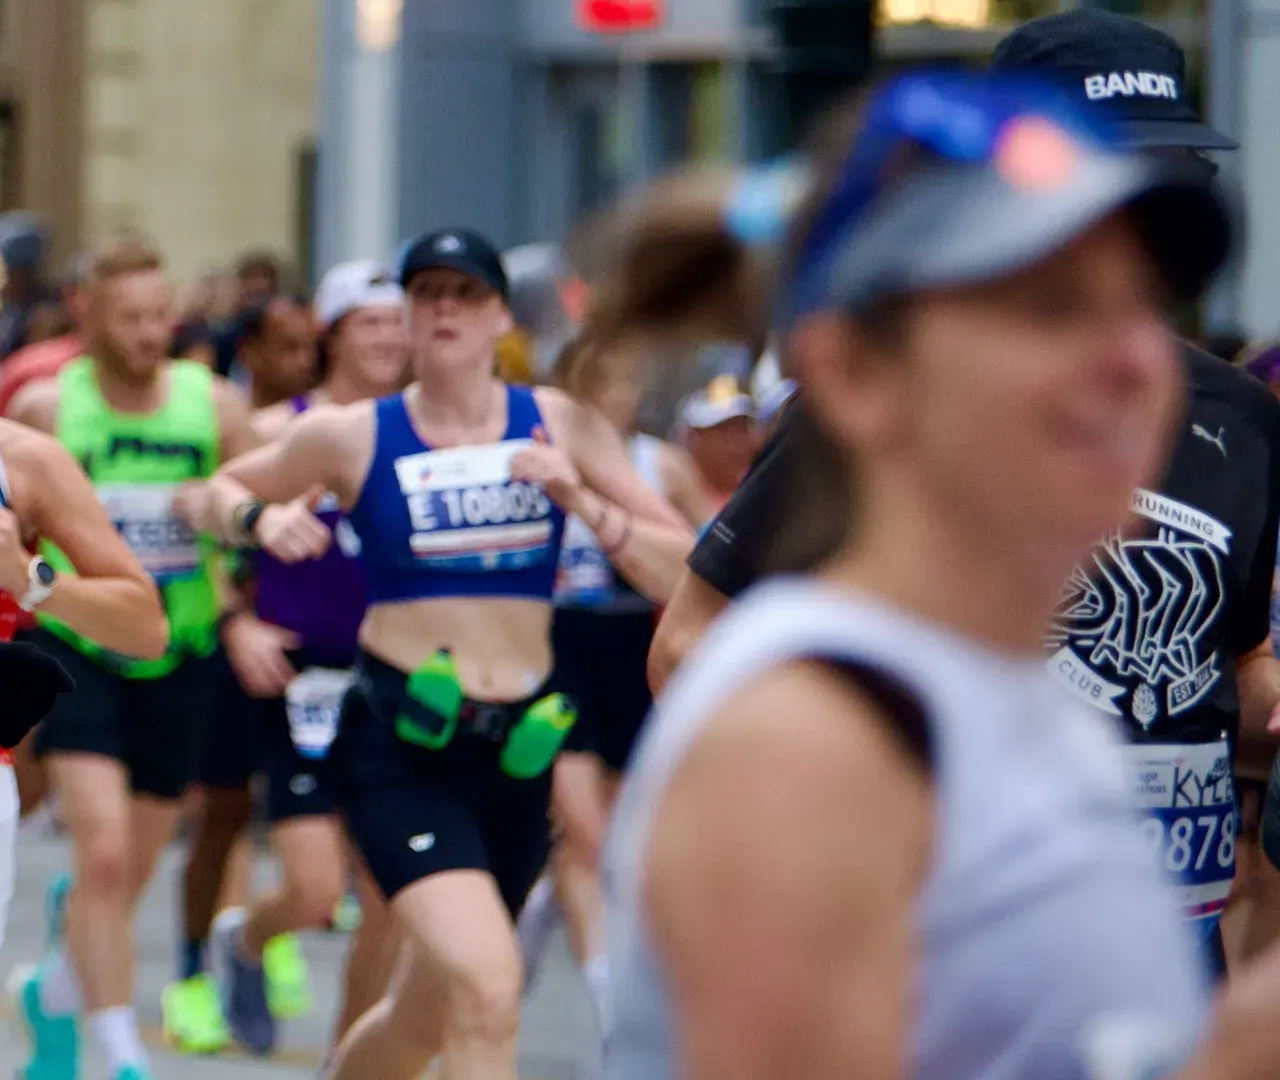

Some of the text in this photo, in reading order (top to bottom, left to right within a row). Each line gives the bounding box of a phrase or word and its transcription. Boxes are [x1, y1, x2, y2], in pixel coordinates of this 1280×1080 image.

[1083, 70, 1177, 101] BANDIT
[407, 492, 438, 532] E
[1132, 493, 1215, 537] RUNNING
[1057, 659, 1103, 698] CLUB
